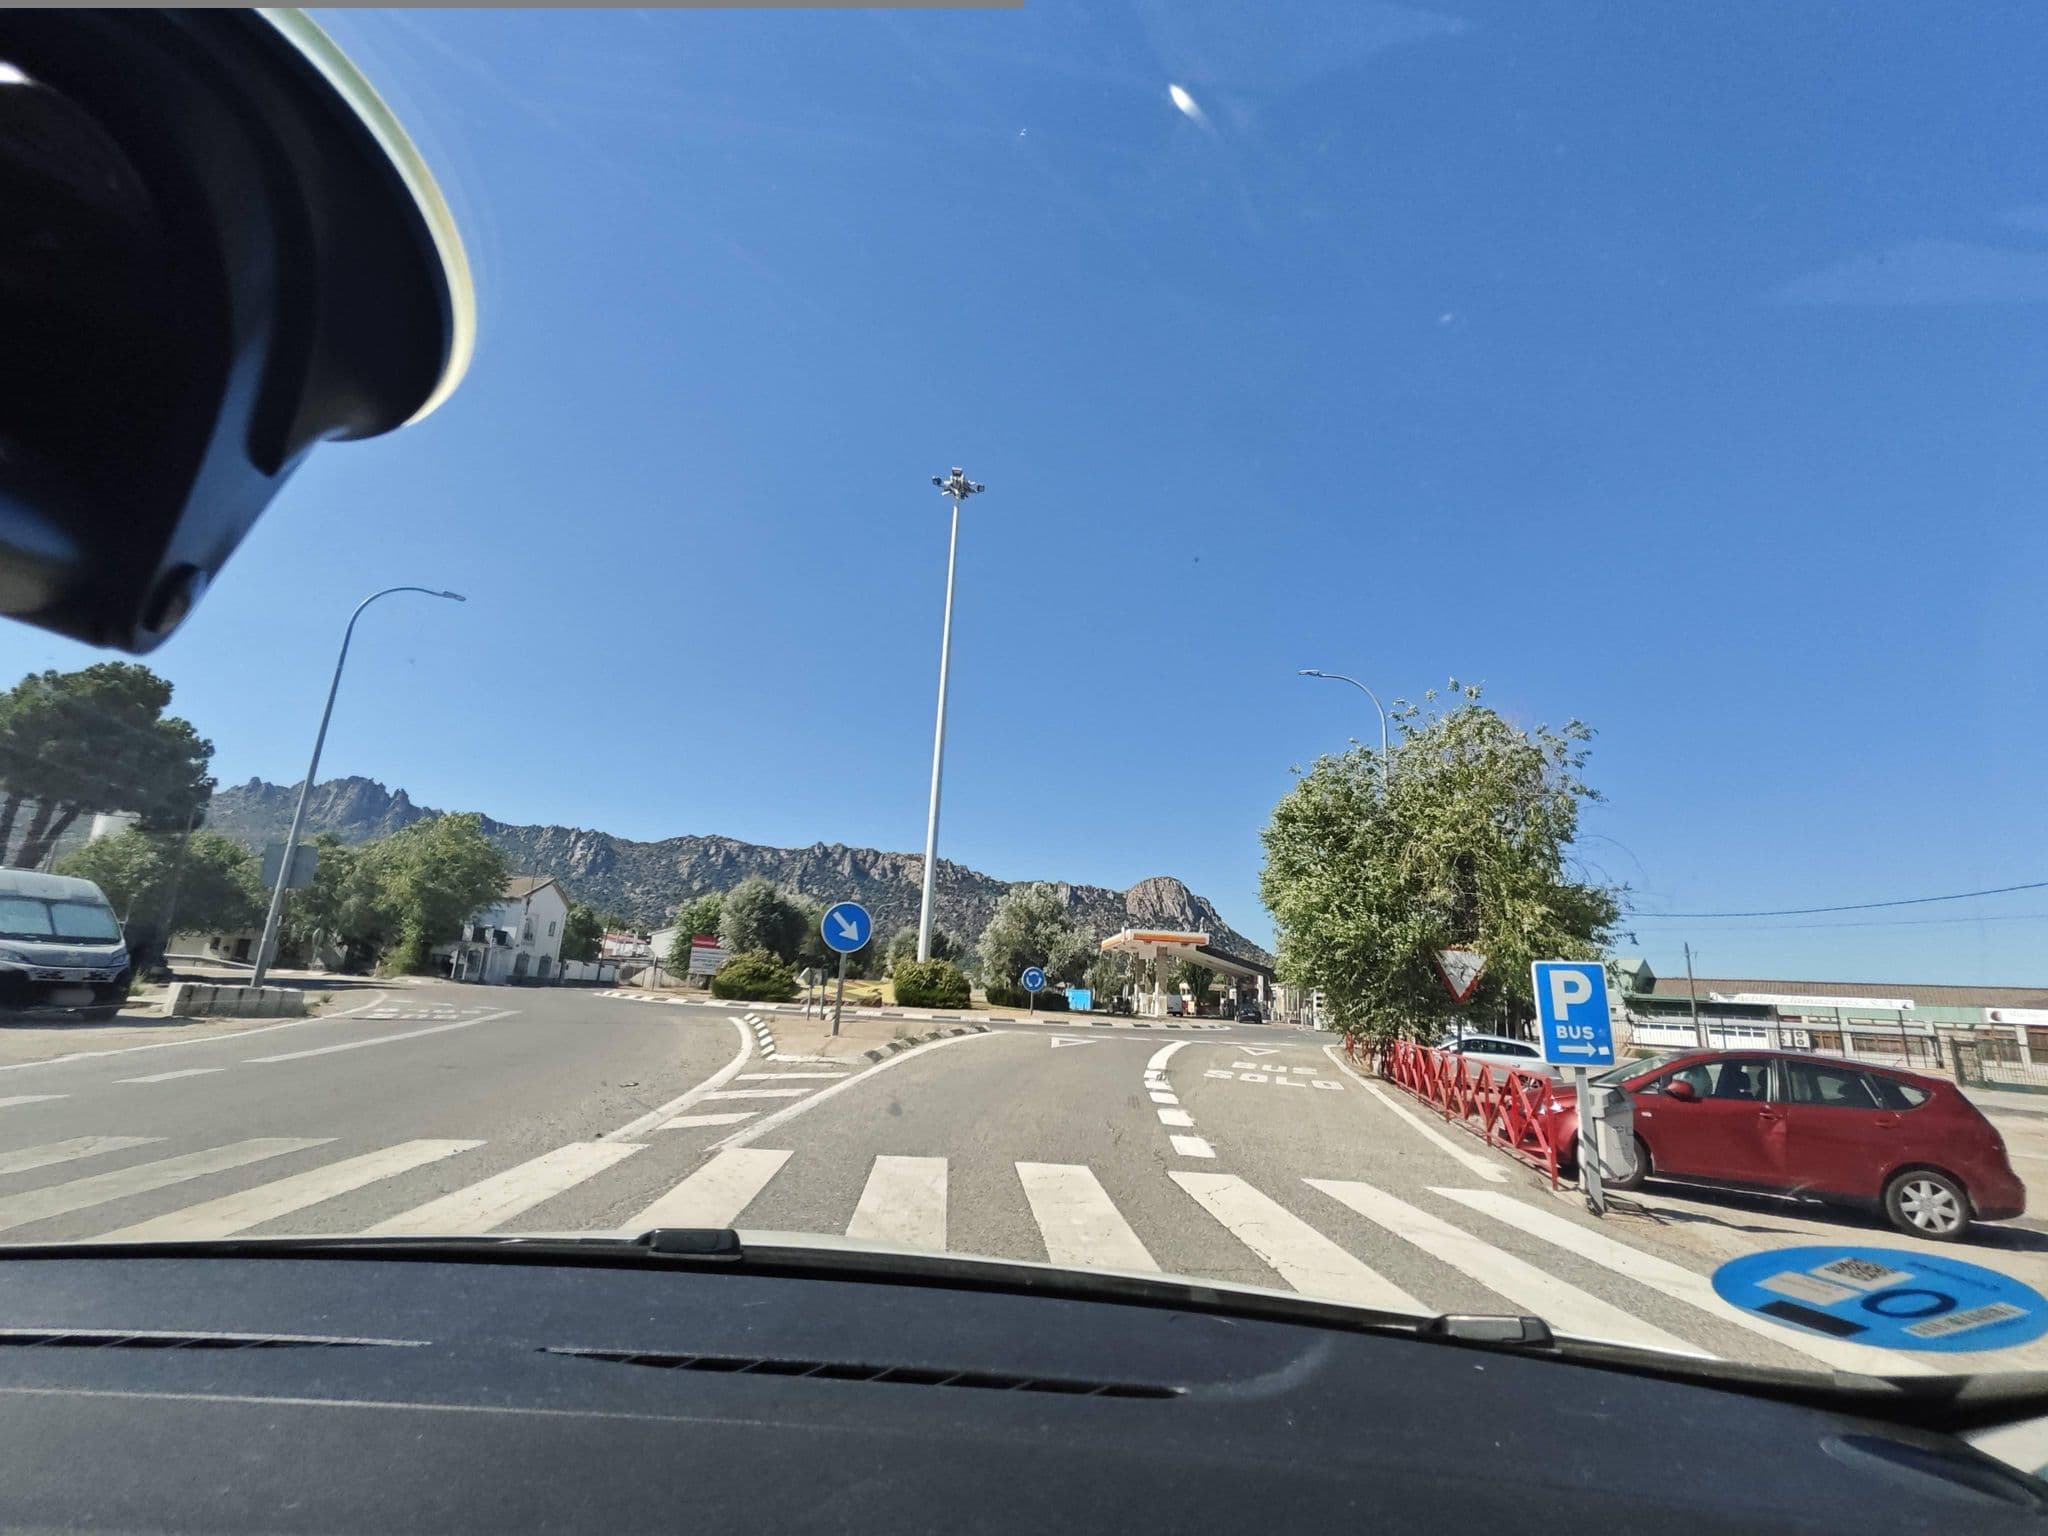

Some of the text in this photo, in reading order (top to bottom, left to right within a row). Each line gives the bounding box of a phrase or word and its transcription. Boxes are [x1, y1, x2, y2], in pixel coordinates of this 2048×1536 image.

[1549, 969, 1592, 1021] P
[1555, 1025, 1595, 1039] BUS
[1203, 1069, 1345, 1090] SOLO
